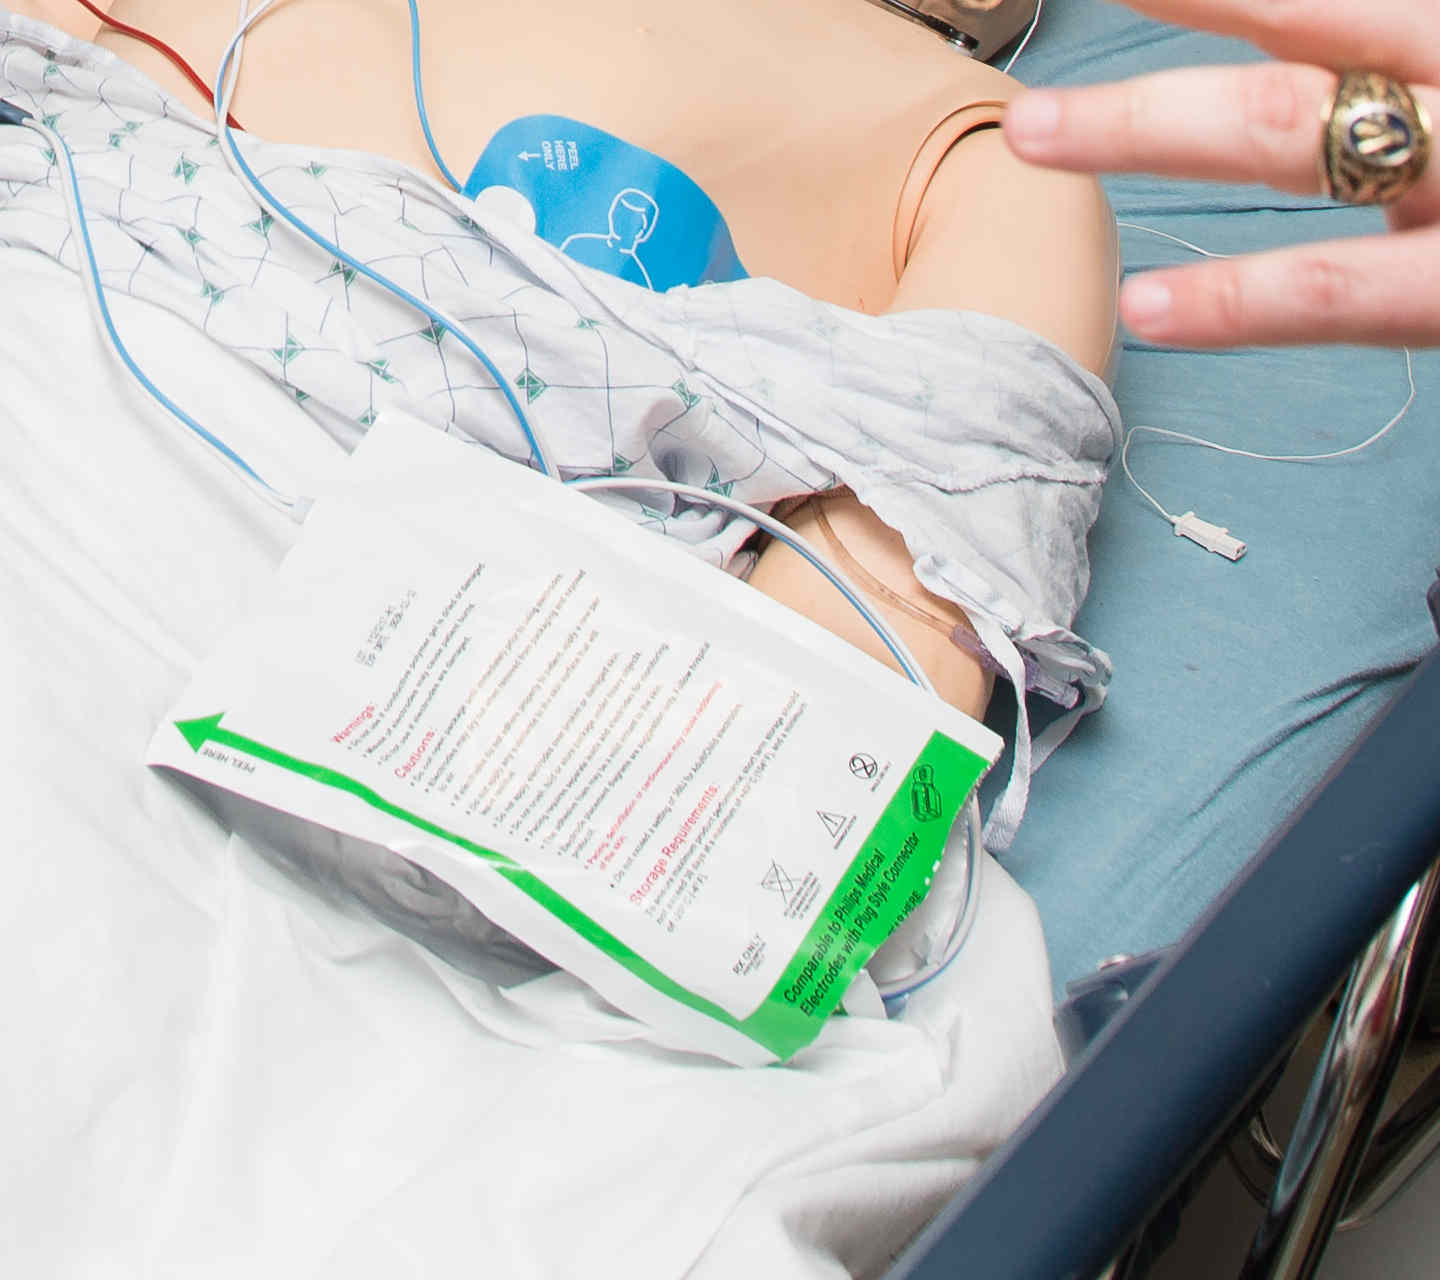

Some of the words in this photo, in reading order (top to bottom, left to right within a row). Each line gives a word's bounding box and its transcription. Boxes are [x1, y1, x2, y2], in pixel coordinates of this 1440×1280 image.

[541, 140, 555, 171] ONLY
[555, 140, 567, 171] HERE
[567, 140, 579, 170] PEEL
[203, 746, 230, 763] HERE
[231, 757, 256, 774] PEEL
[626, 857, 668, 907] Storage
[656, 777, 724, 865] Requirements:
[854, 847, 886, 889] Medical
[834, 885, 864, 923] Philips
[798, 950, 847, 1016] Electrodes
[839, 926, 862, 954] with
[853, 903, 878, 931] Plug
[868, 879, 894, 909] Style
[883, 830, 923, 884] Connector
[827, 918, 842, 934] to
[738, 932, 764, 961] ONLY
[782, 932, 835, 1005] Comparable
